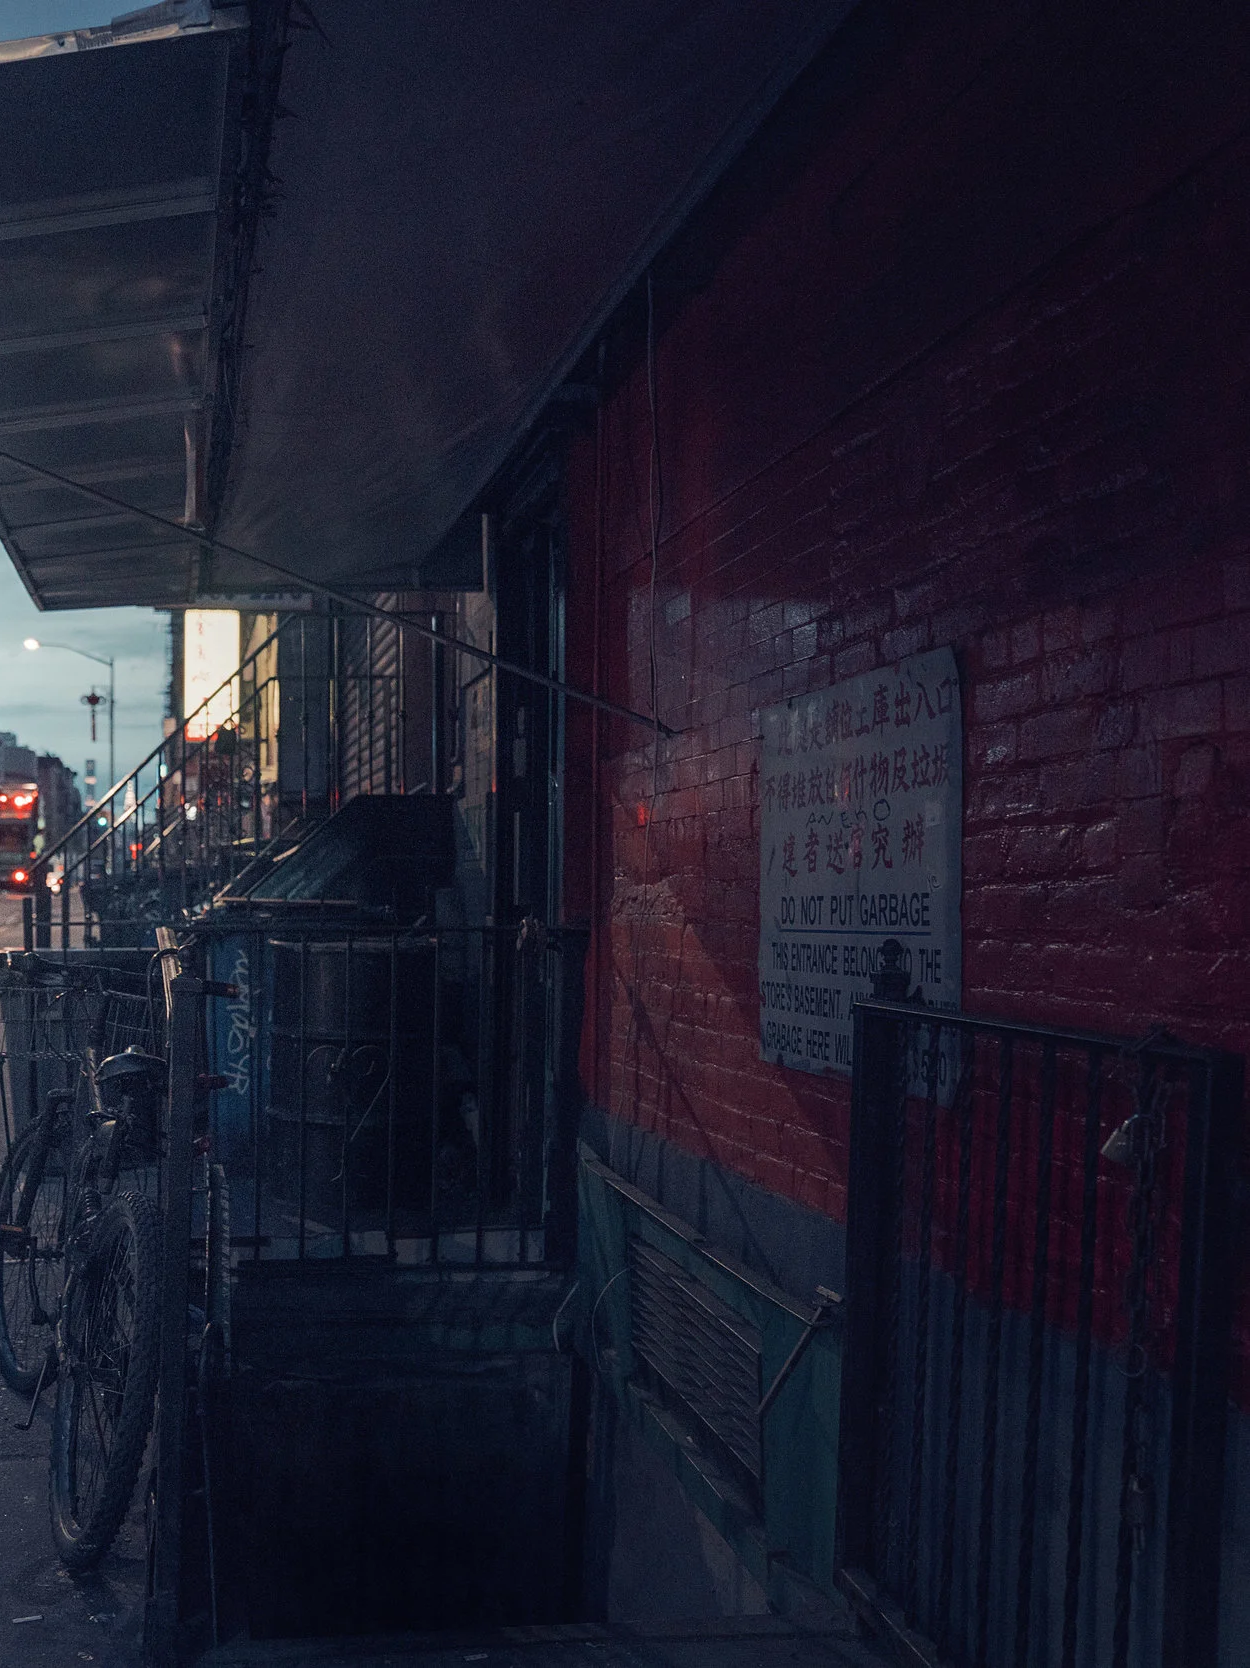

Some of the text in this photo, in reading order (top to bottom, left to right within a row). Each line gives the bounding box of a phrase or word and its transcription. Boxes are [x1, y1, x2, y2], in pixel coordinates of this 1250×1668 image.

[780, 892, 931, 928] DO NOT PUT GARBAGE
[771, 942, 788, 971] THIS
[790, 943, 838, 975] ENTRANCE
[843, 945, 884, 978] BELONG
[918, 949, 942, 984] THE
[761, 980, 792, 1013] STORE'S
[766, 1020, 802, 1055] GRABAGE
[806, 1028, 830, 1062] HERE
